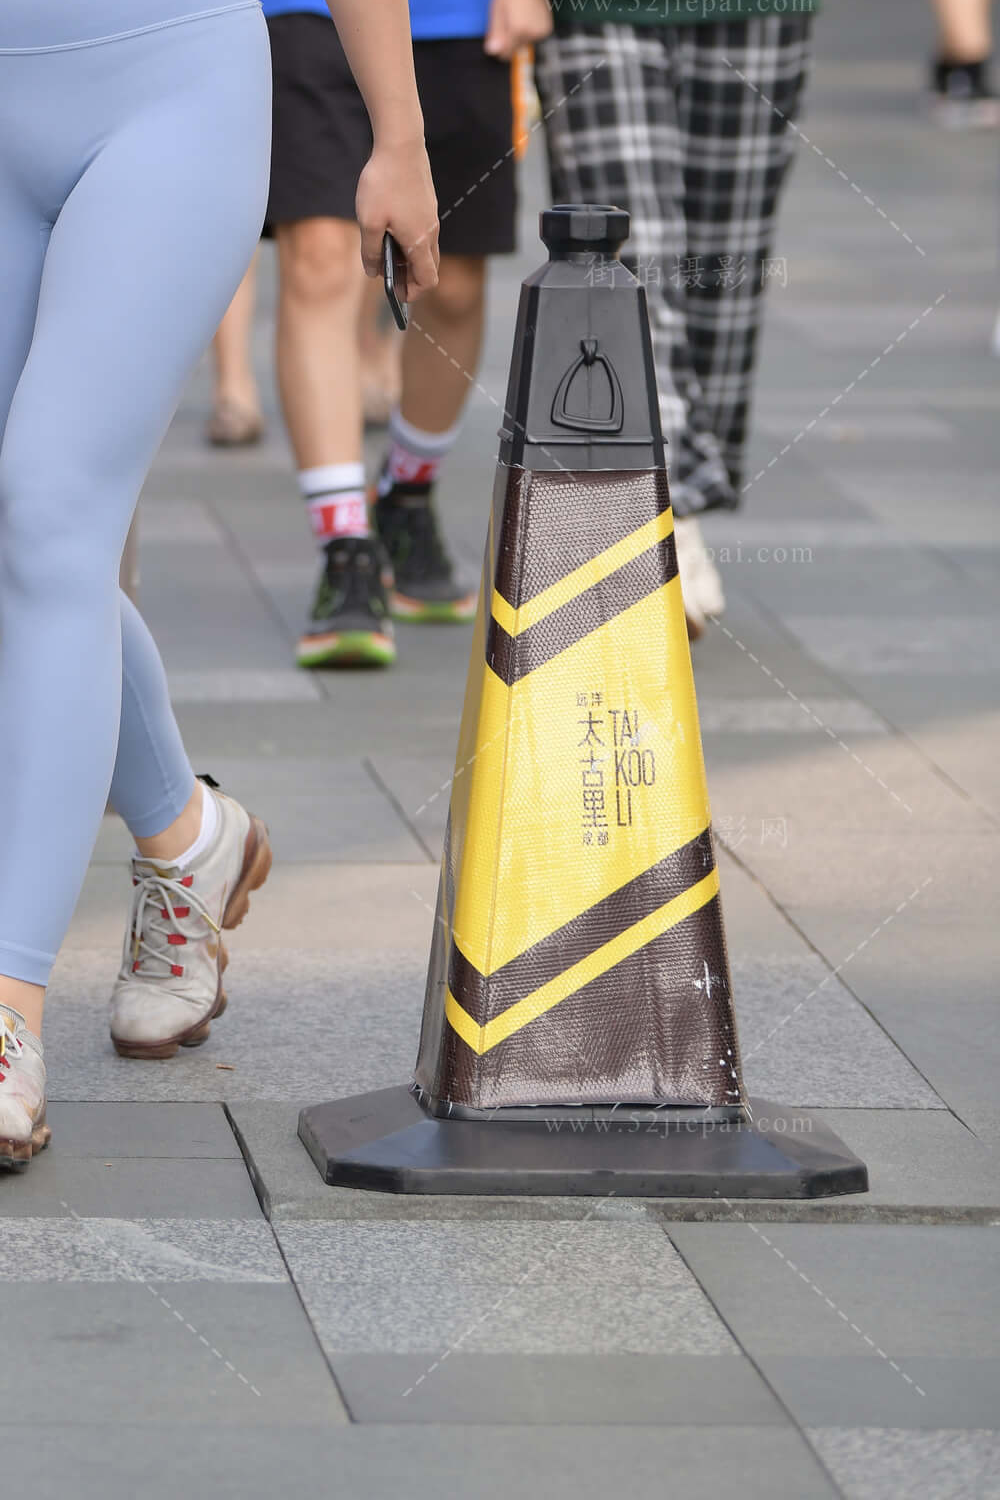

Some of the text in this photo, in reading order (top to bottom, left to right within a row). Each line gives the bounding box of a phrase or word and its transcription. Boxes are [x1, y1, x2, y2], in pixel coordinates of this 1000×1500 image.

[607, 710, 639, 747] TAI
[614, 749, 656, 787] KOO
[616, 788, 632, 827] LI
